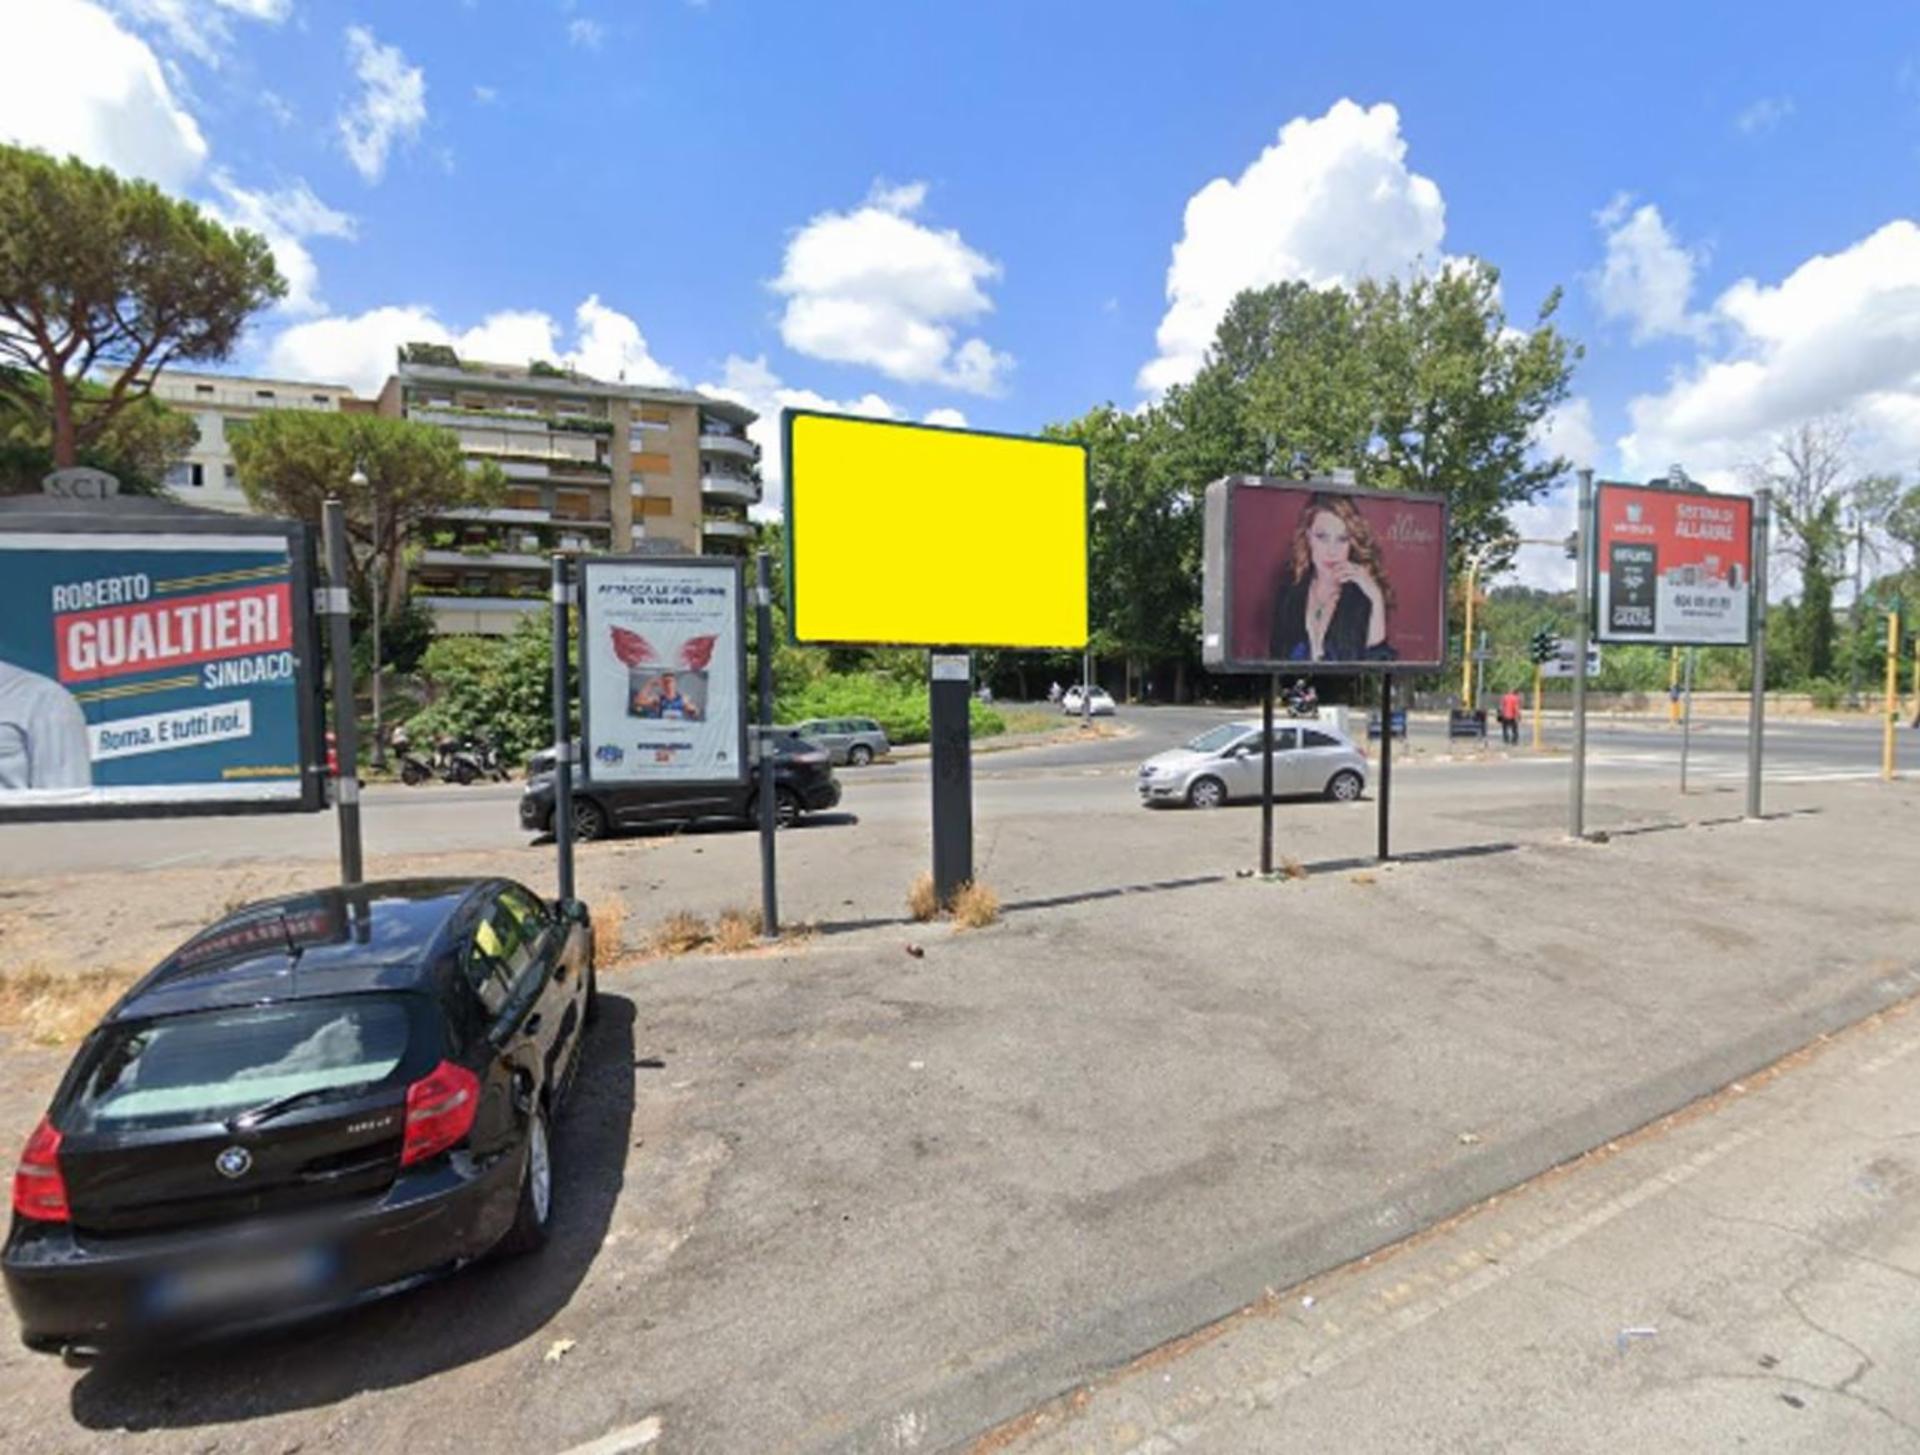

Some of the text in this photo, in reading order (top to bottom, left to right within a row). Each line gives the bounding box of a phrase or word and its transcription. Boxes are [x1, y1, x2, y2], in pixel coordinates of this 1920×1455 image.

[53, 573, 149, 611] ROBERTO
[66, 594, 279, 672] GUALTIERI
[203, 651, 293, 690] SINDACO
[101, 708, 244, 750] Roma. E tutti noi.
